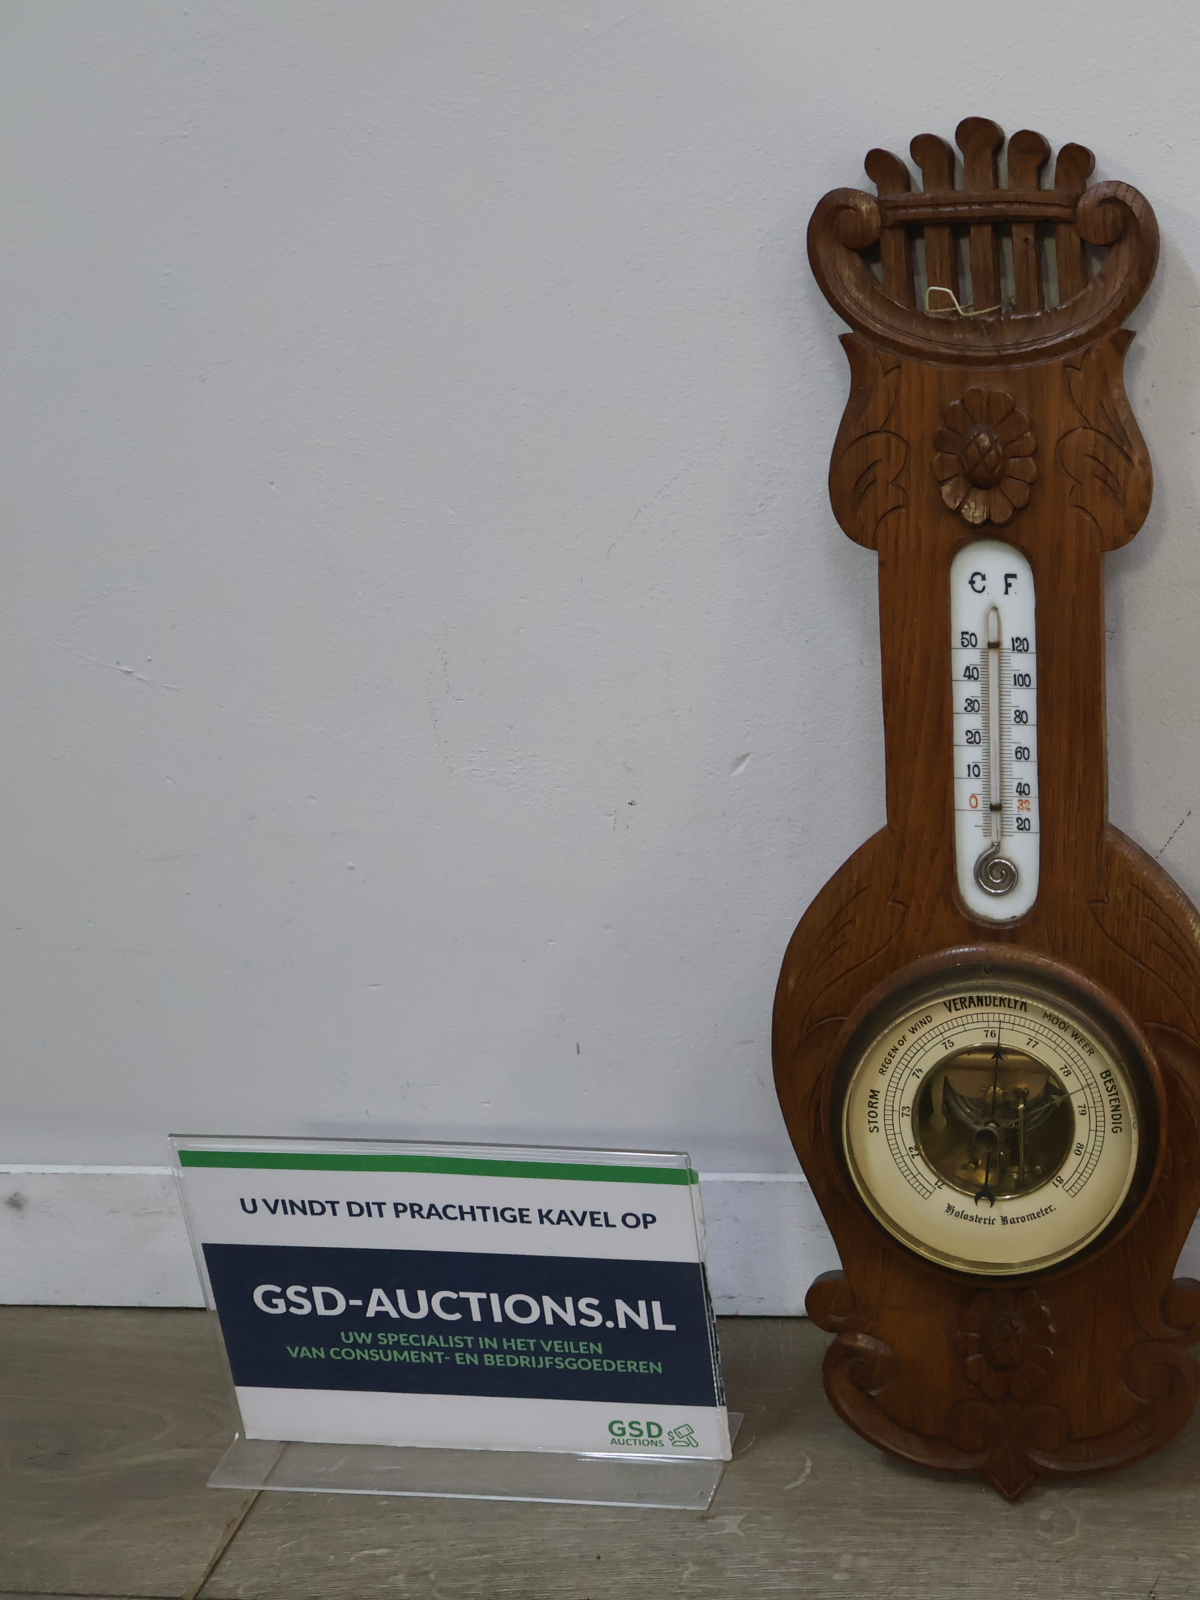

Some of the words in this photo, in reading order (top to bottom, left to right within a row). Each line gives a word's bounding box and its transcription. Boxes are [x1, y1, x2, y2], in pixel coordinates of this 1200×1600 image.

[960, 631, 978, 648] 50
[1011, 636, 1029, 653] 120
[963, 665, 980, 681] 40
[1012, 673, 1031, 688] 100
[963, 697, 981, 713] 30
[1013, 709, 1029, 724] 80
[965, 729, 982, 745] 20
[1014, 746, 1031, 761] 60
[966, 763, 981, 778] 10
[1015, 782, 1031, 796] 40
[969, 794, 979, 809] 0
[1016, 798, 1032, 812] 32
[1015, 816, 1032, 832] 20
[983, 1029, 997, 1039] 76
[1041, 1011, 1070, 1032] MOOI
[1070, 1030, 1096, 1057] WEER
[878, 1045, 900, 1076] REGEN
[897, 1034, 908, 1047] OF
[907, 1014, 934, 1035] WIND
[941, 1039, 955, 1051] 75
[1025, 1037, 1040, 1049] 77
[911, 1066, 924, 1080] 74
[1059, 1064, 1072, 1078] 78
[1099, 1069, 1123, 1134] BESTENDIG
[867, 1088, 881, 1134] STORM
[901, 1105, 911, 1118] 73
[1077, 1103, 1088, 1116] 79
[908, 1145, 921, 1160] 72
[1073, 1142, 1085, 1157] 80
[933, 1178, 945, 1191] 71
[1051, 1175, 1065, 1189] 81
[240, 1198, 258, 1214] U
[262, 1198, 340, 1217] VINDT
[346, 1201, 386, 1218] DIT
[393, 1202, 532, 1225] PRACHTIGE
[538, 1208, 616, 1229] KAVEL
[621, 1212, 657, 1230] OP
[944, 1202, 997, 1226] Holosteric
[253, 1283, 677, 1332] GSD-AUCTIONS.NL
[340, 1331, 373, 1344] UW
[377, 1332, 474, 1349] SPECIALIST
[478, 1337, 498, 1350] IN
[502, 1338, 537, 1352] HET
[540, 1339, 603, 1355] VEILEN
[286, 1346, 326, 1359] VAN
[330, 1347, 450, 1365] CONSUMENT-
[455, 1352, 479, 1366] EN
[483, 1353, 663, 1374] BEDRIJFSGOEDEREN
[608, 1420, 663, 1439] GSD
[610, 1438, 664, 1447] AUCTIONS
